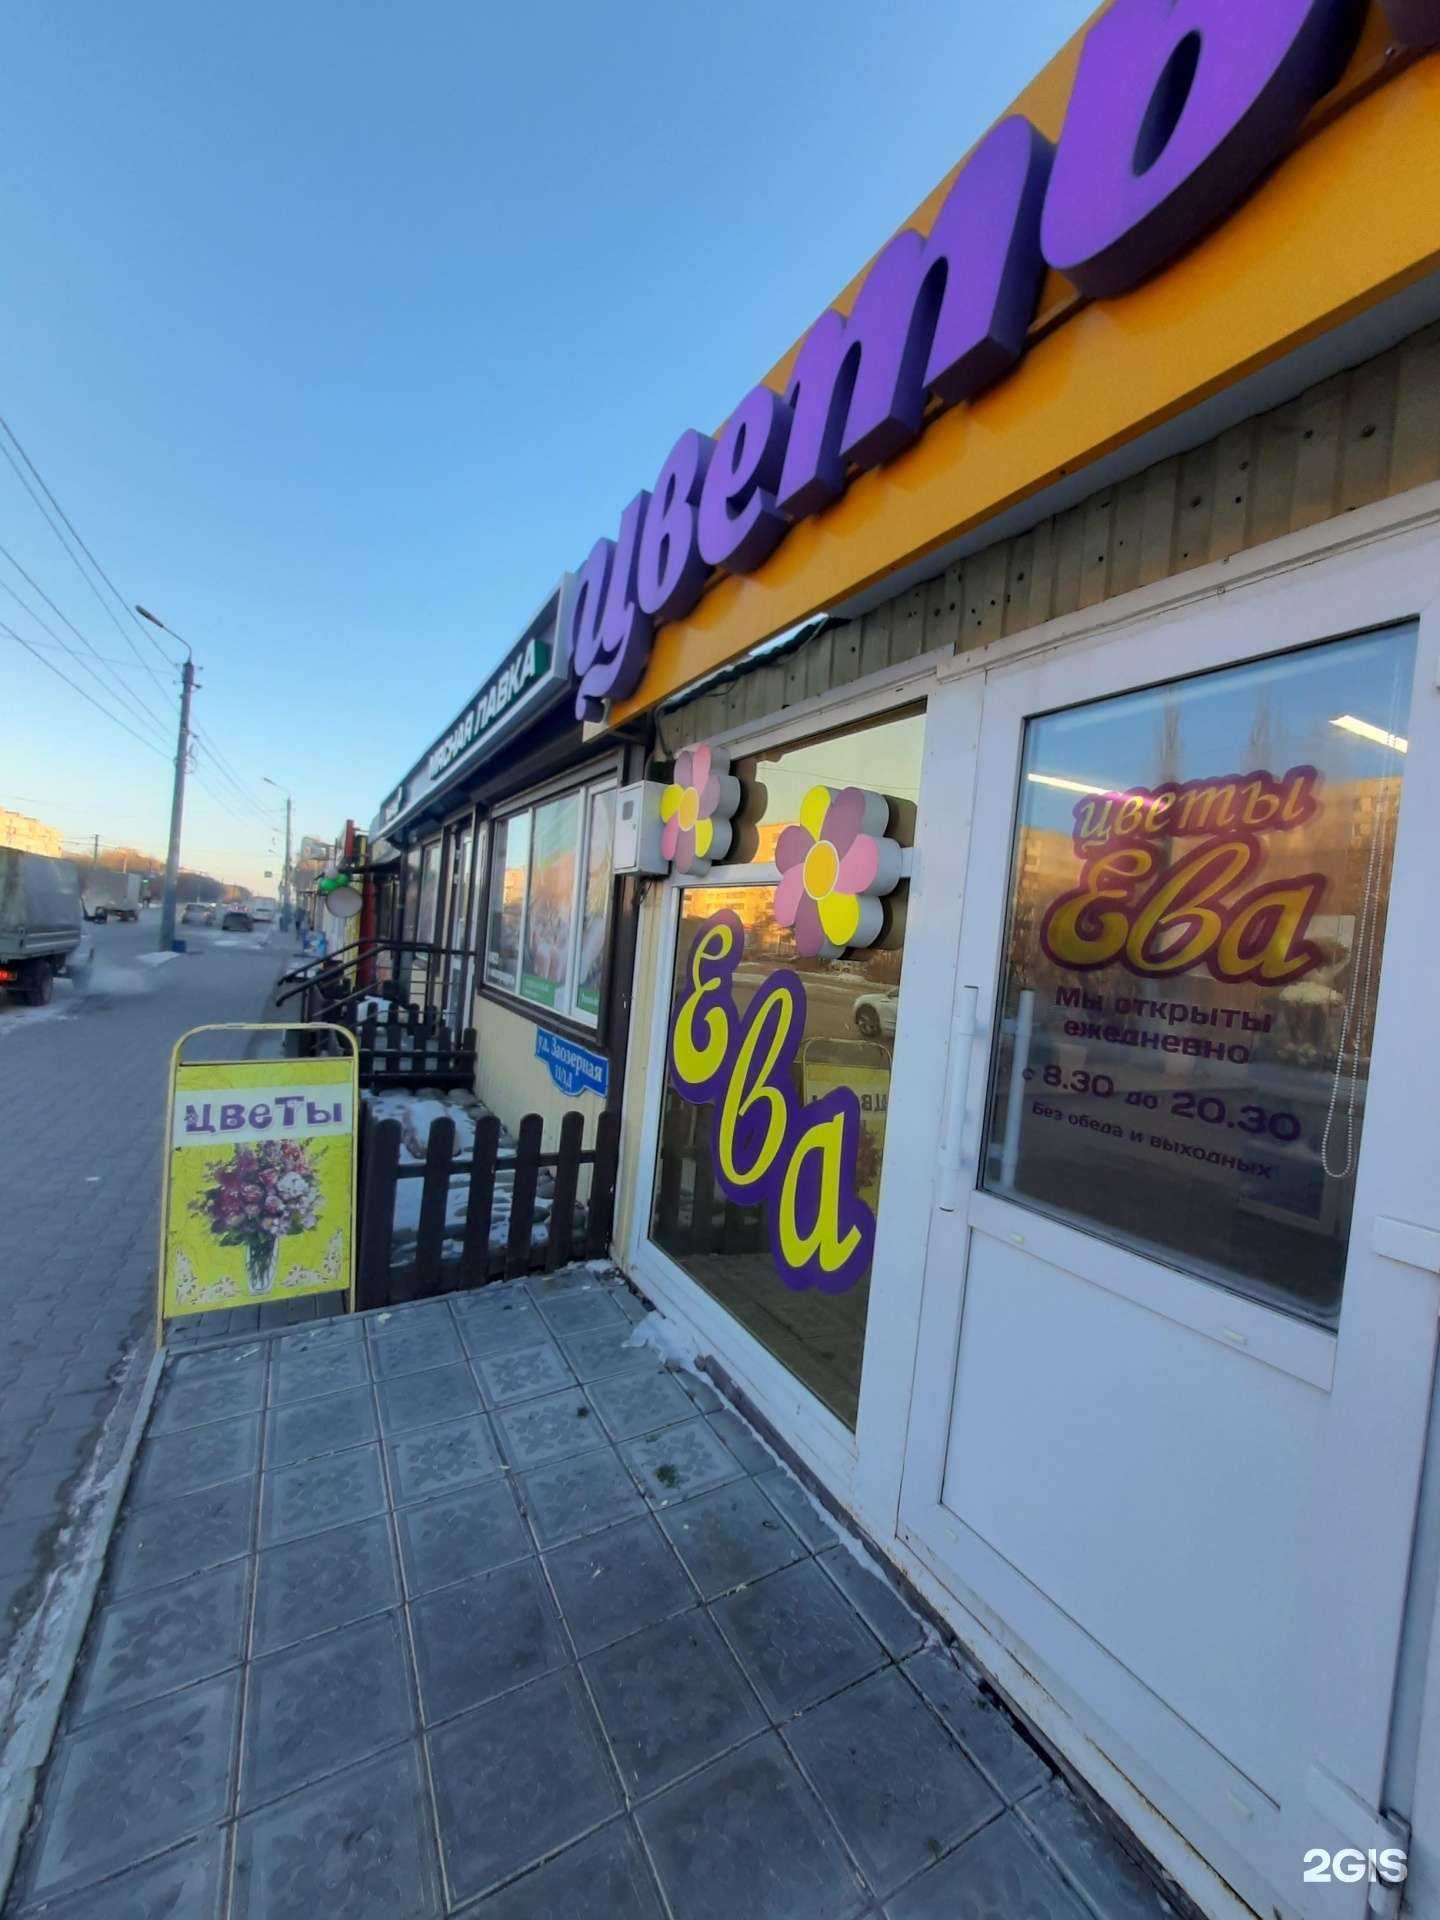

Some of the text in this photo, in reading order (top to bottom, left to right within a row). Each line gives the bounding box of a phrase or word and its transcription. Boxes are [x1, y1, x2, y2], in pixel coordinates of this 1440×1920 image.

[474, 638, 536, 738] ЛАВКА
[1047, 842, 1314, 979] Ева
[1055, 985, 1273, 1033] Мы открыты
[1063, 1020, 1250, 1065] ежедневно
[550, 1036, 603, 1083] Заозерная
[1031, 1101, 1273, 1180] Без обеда и выходных
[1042, 1064, 1115, 1098] 8.30
[1124, 1090, 1158, 1110] до
[1171, 1091, 1301, 1142] 20.30
